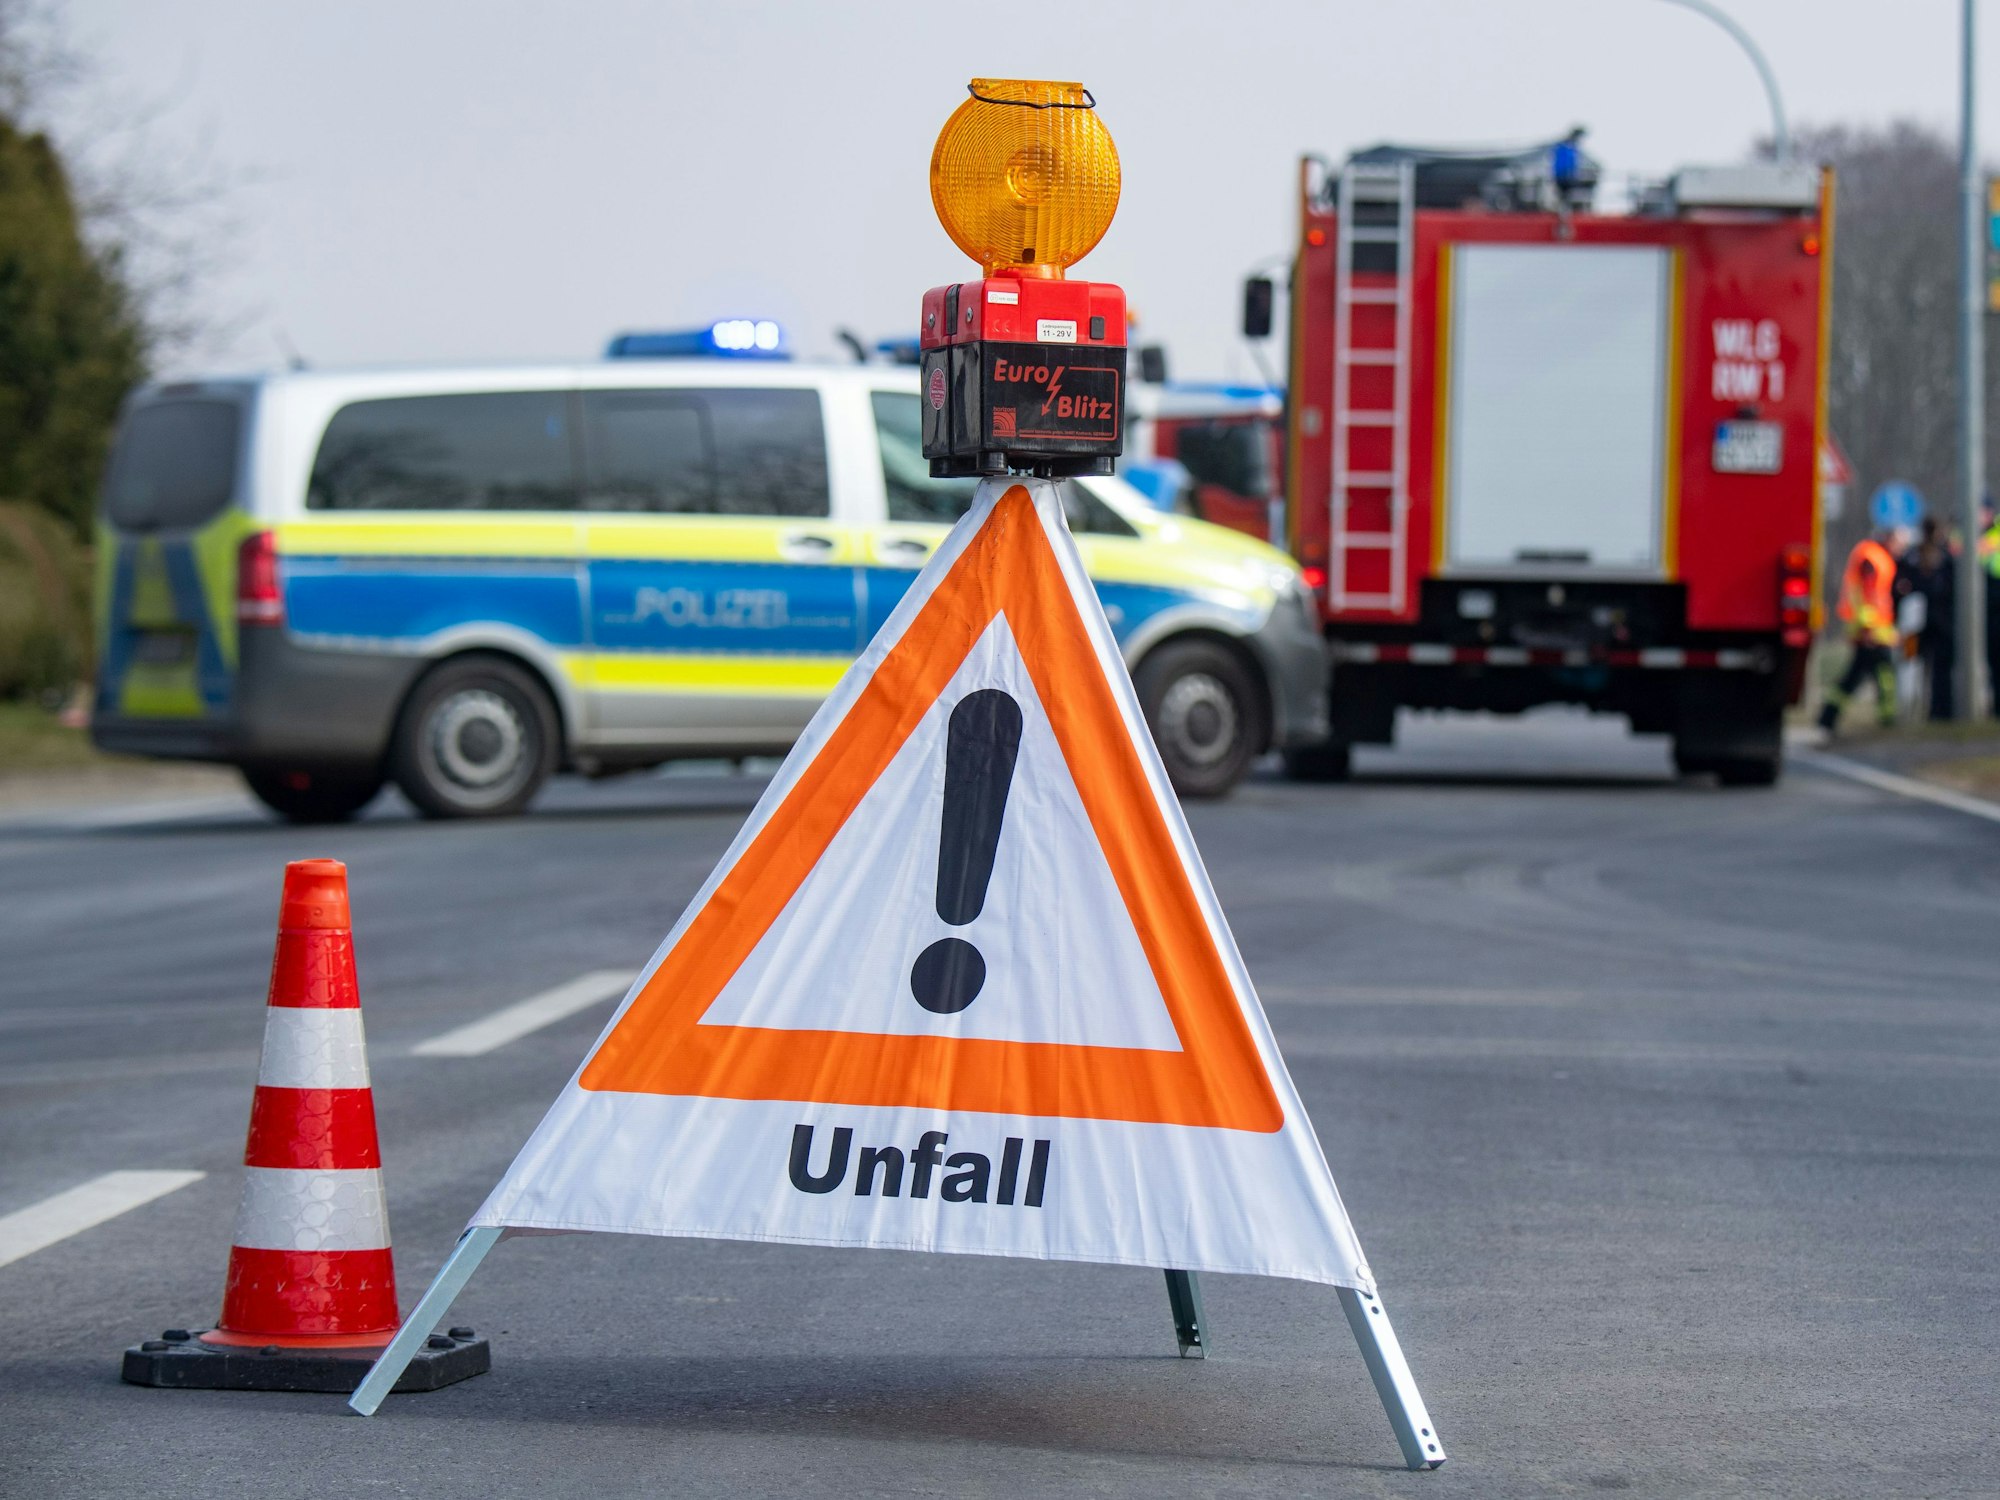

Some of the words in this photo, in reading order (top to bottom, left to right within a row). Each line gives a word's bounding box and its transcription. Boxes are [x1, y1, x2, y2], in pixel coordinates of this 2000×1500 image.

[994, 359, 1049, 384] Euro
[1057, 396, 1112, 420] Blitz
[635, 587, 788, 628] POLIZEI
[788, 1124, 1050, 1207] Unfall
